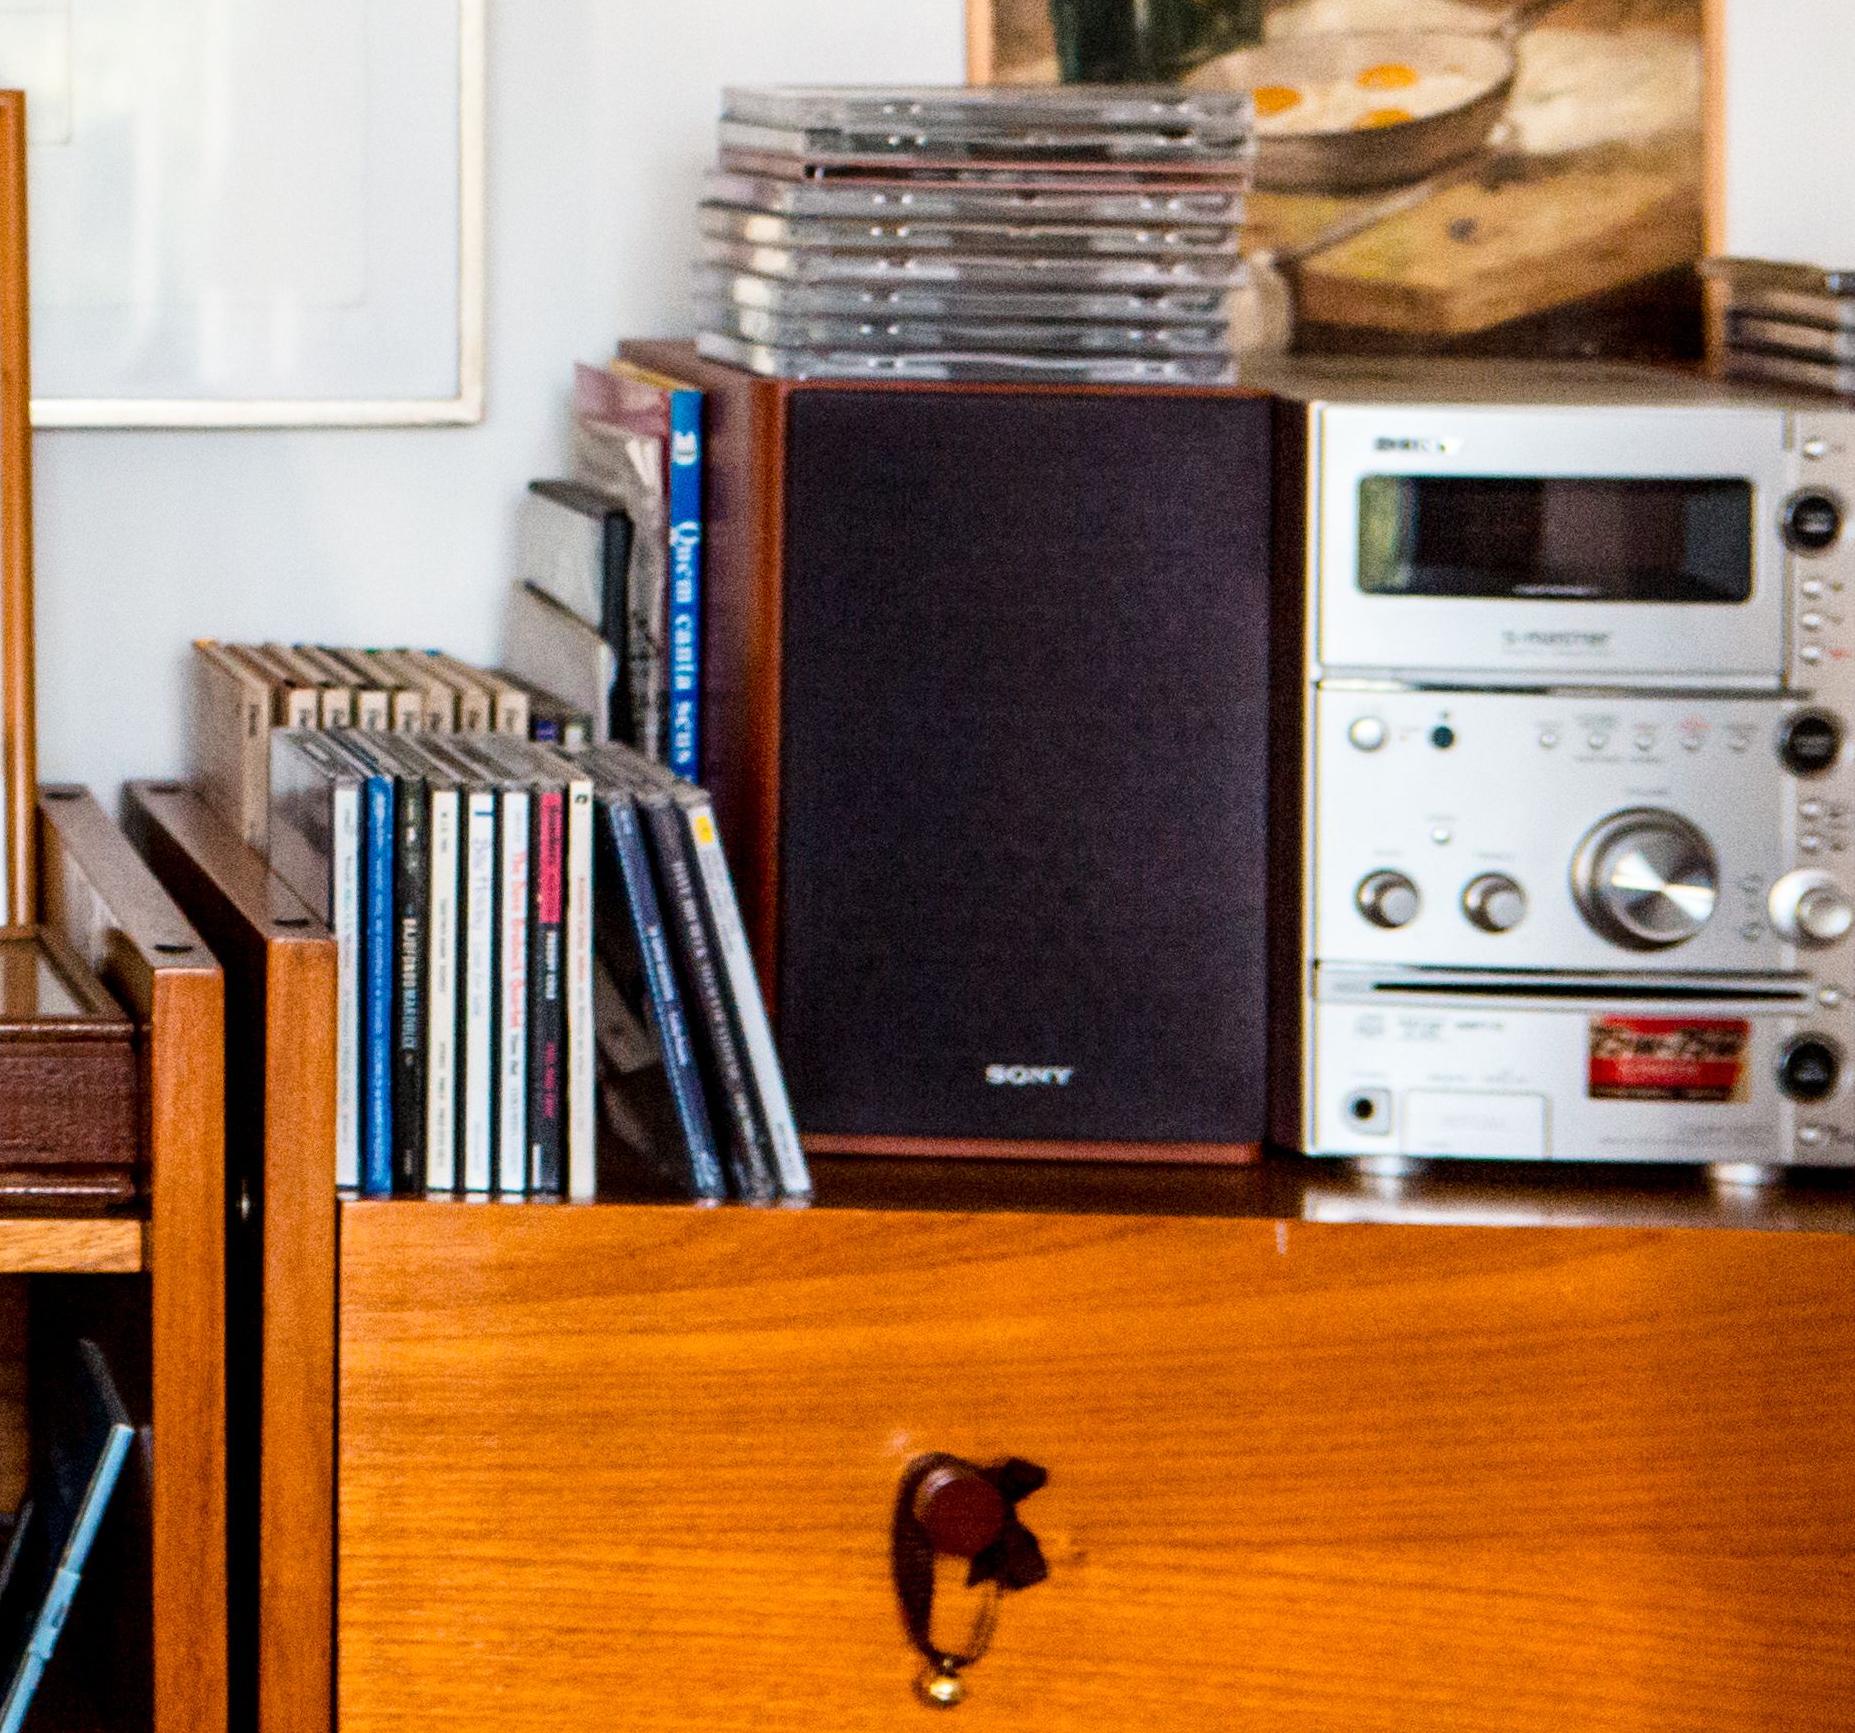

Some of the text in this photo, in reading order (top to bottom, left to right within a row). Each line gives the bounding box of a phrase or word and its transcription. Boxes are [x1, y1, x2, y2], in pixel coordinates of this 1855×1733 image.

[669, 521, 701, 765] Quem canta seus
[985, 1063, 1075, 1087] SONY
